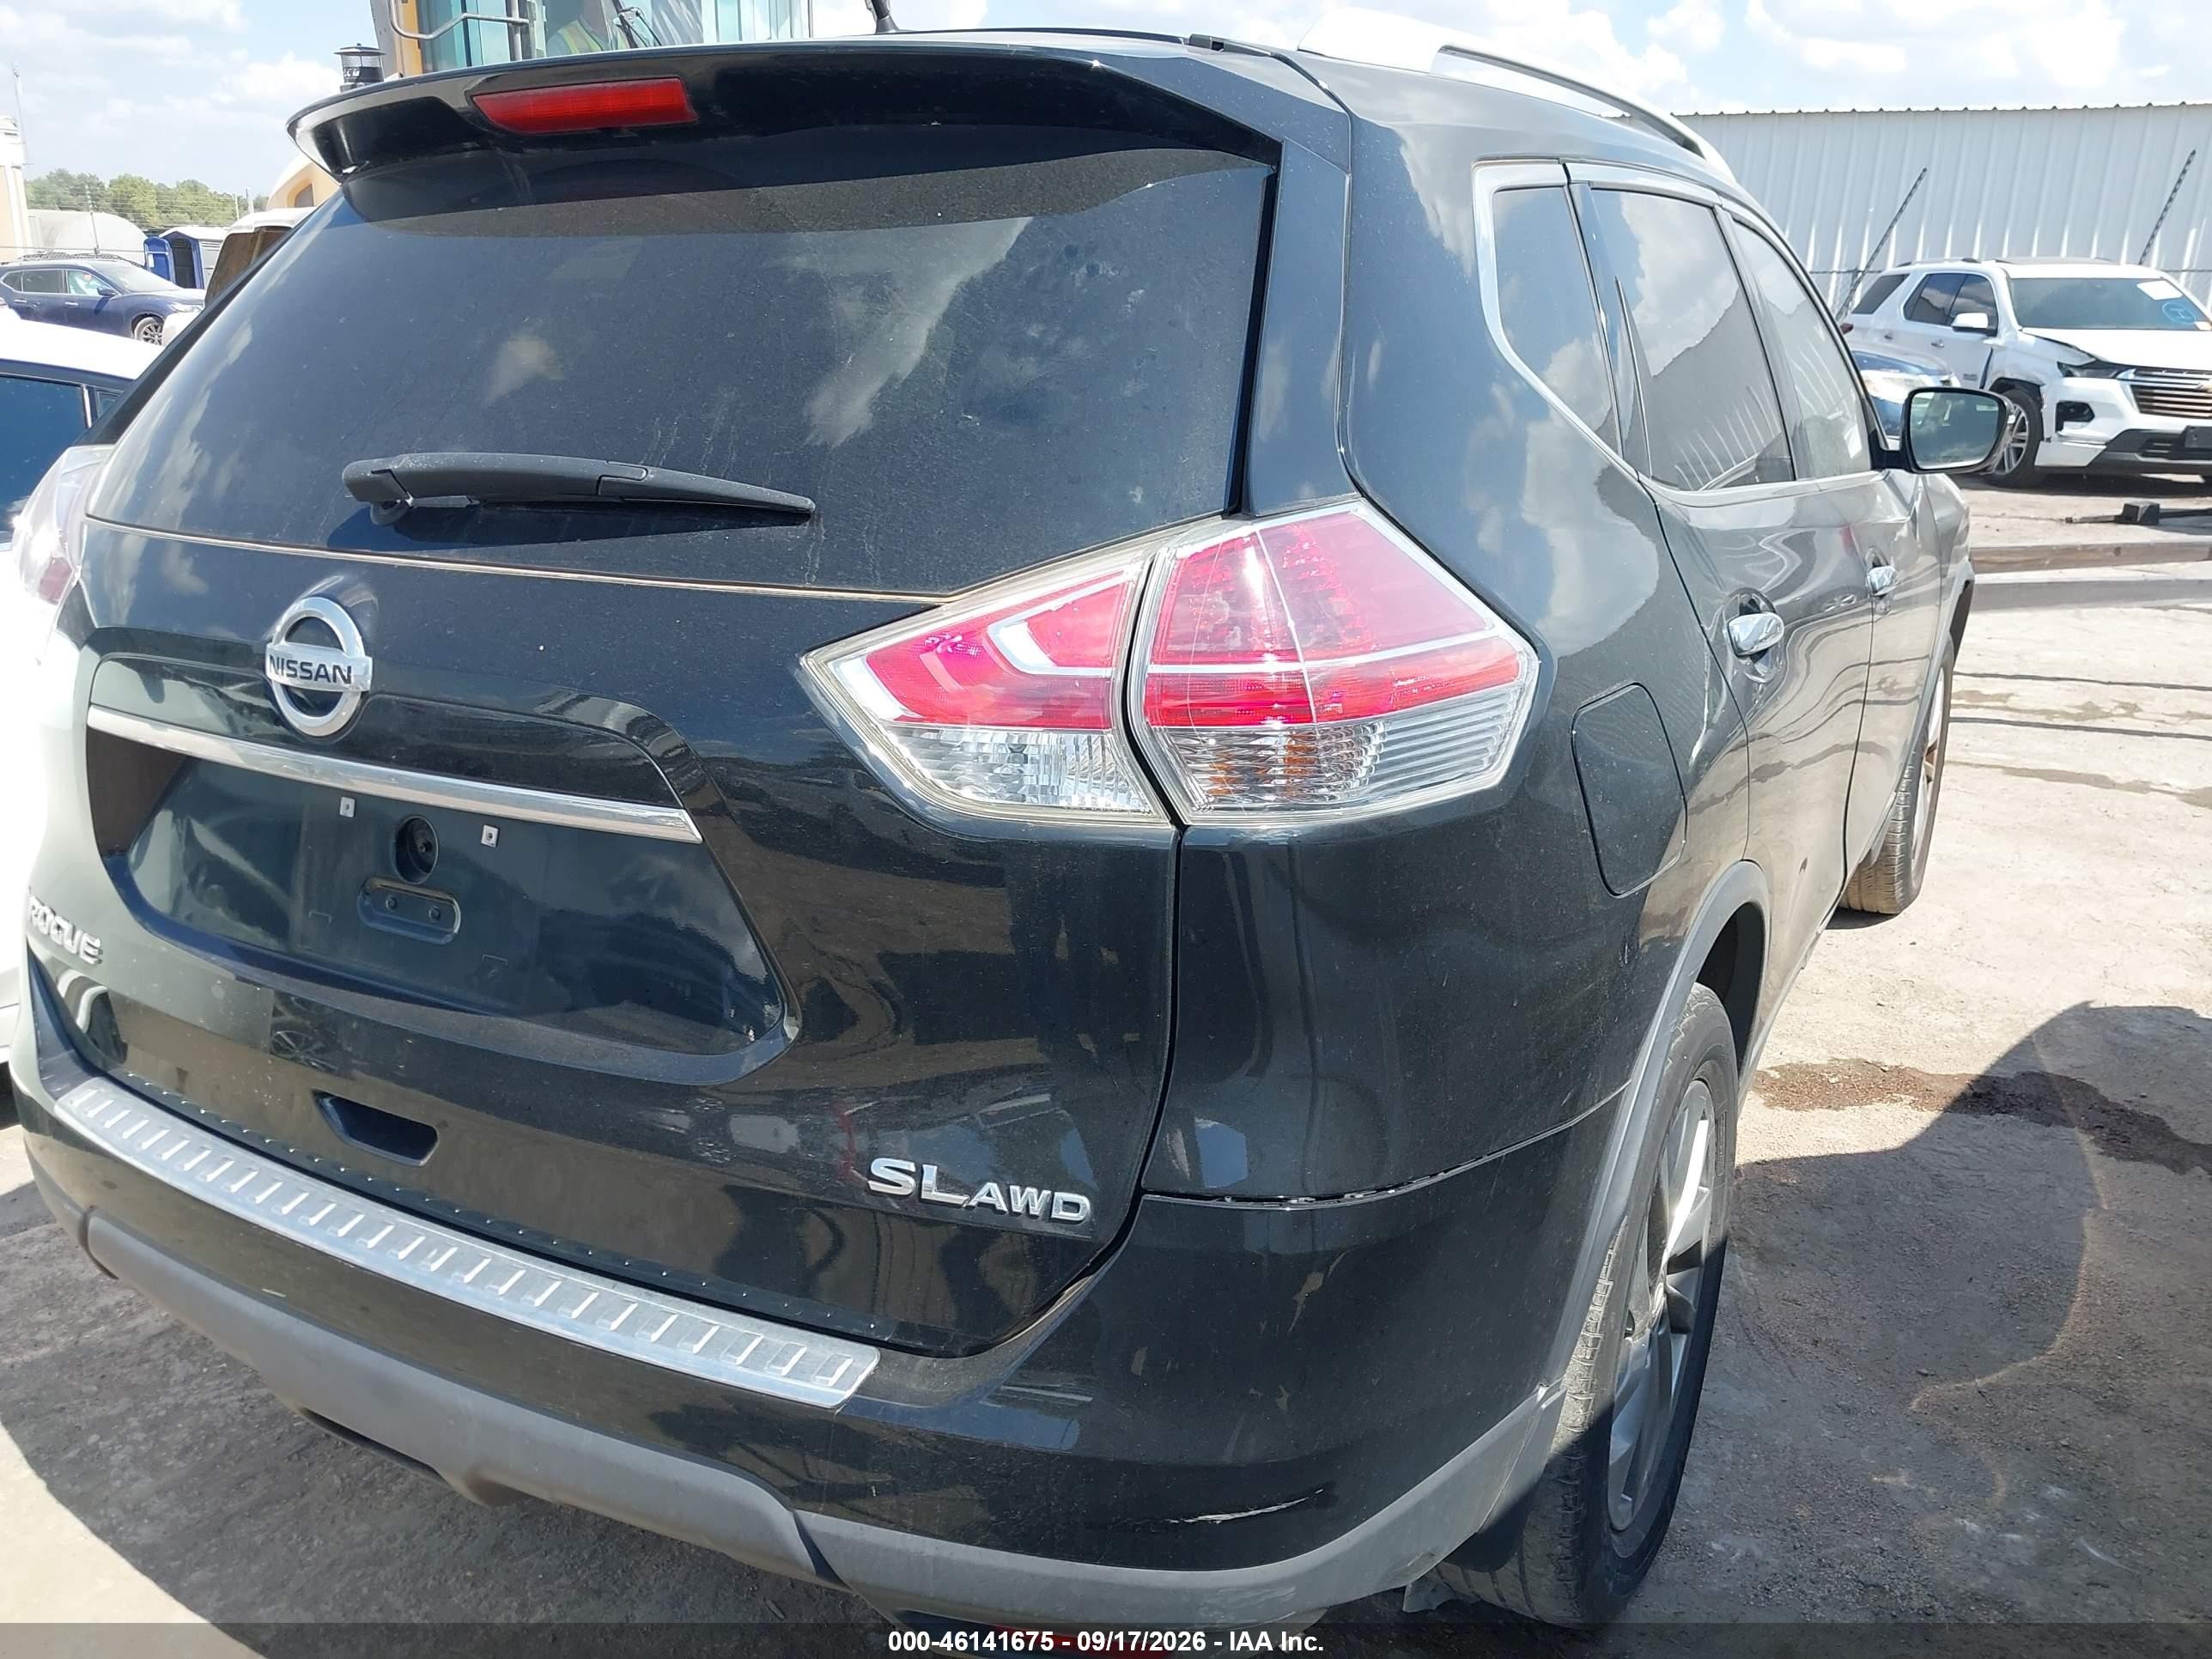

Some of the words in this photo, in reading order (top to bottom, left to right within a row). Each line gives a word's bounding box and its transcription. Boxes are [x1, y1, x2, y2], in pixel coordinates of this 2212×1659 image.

[269, 654, 353, 685] NISSAN
[28, 896, 102, 965] ROGUE
[866, 1157, 970, 1206] SL
[963, 1181, 1092, 1223] AWD
